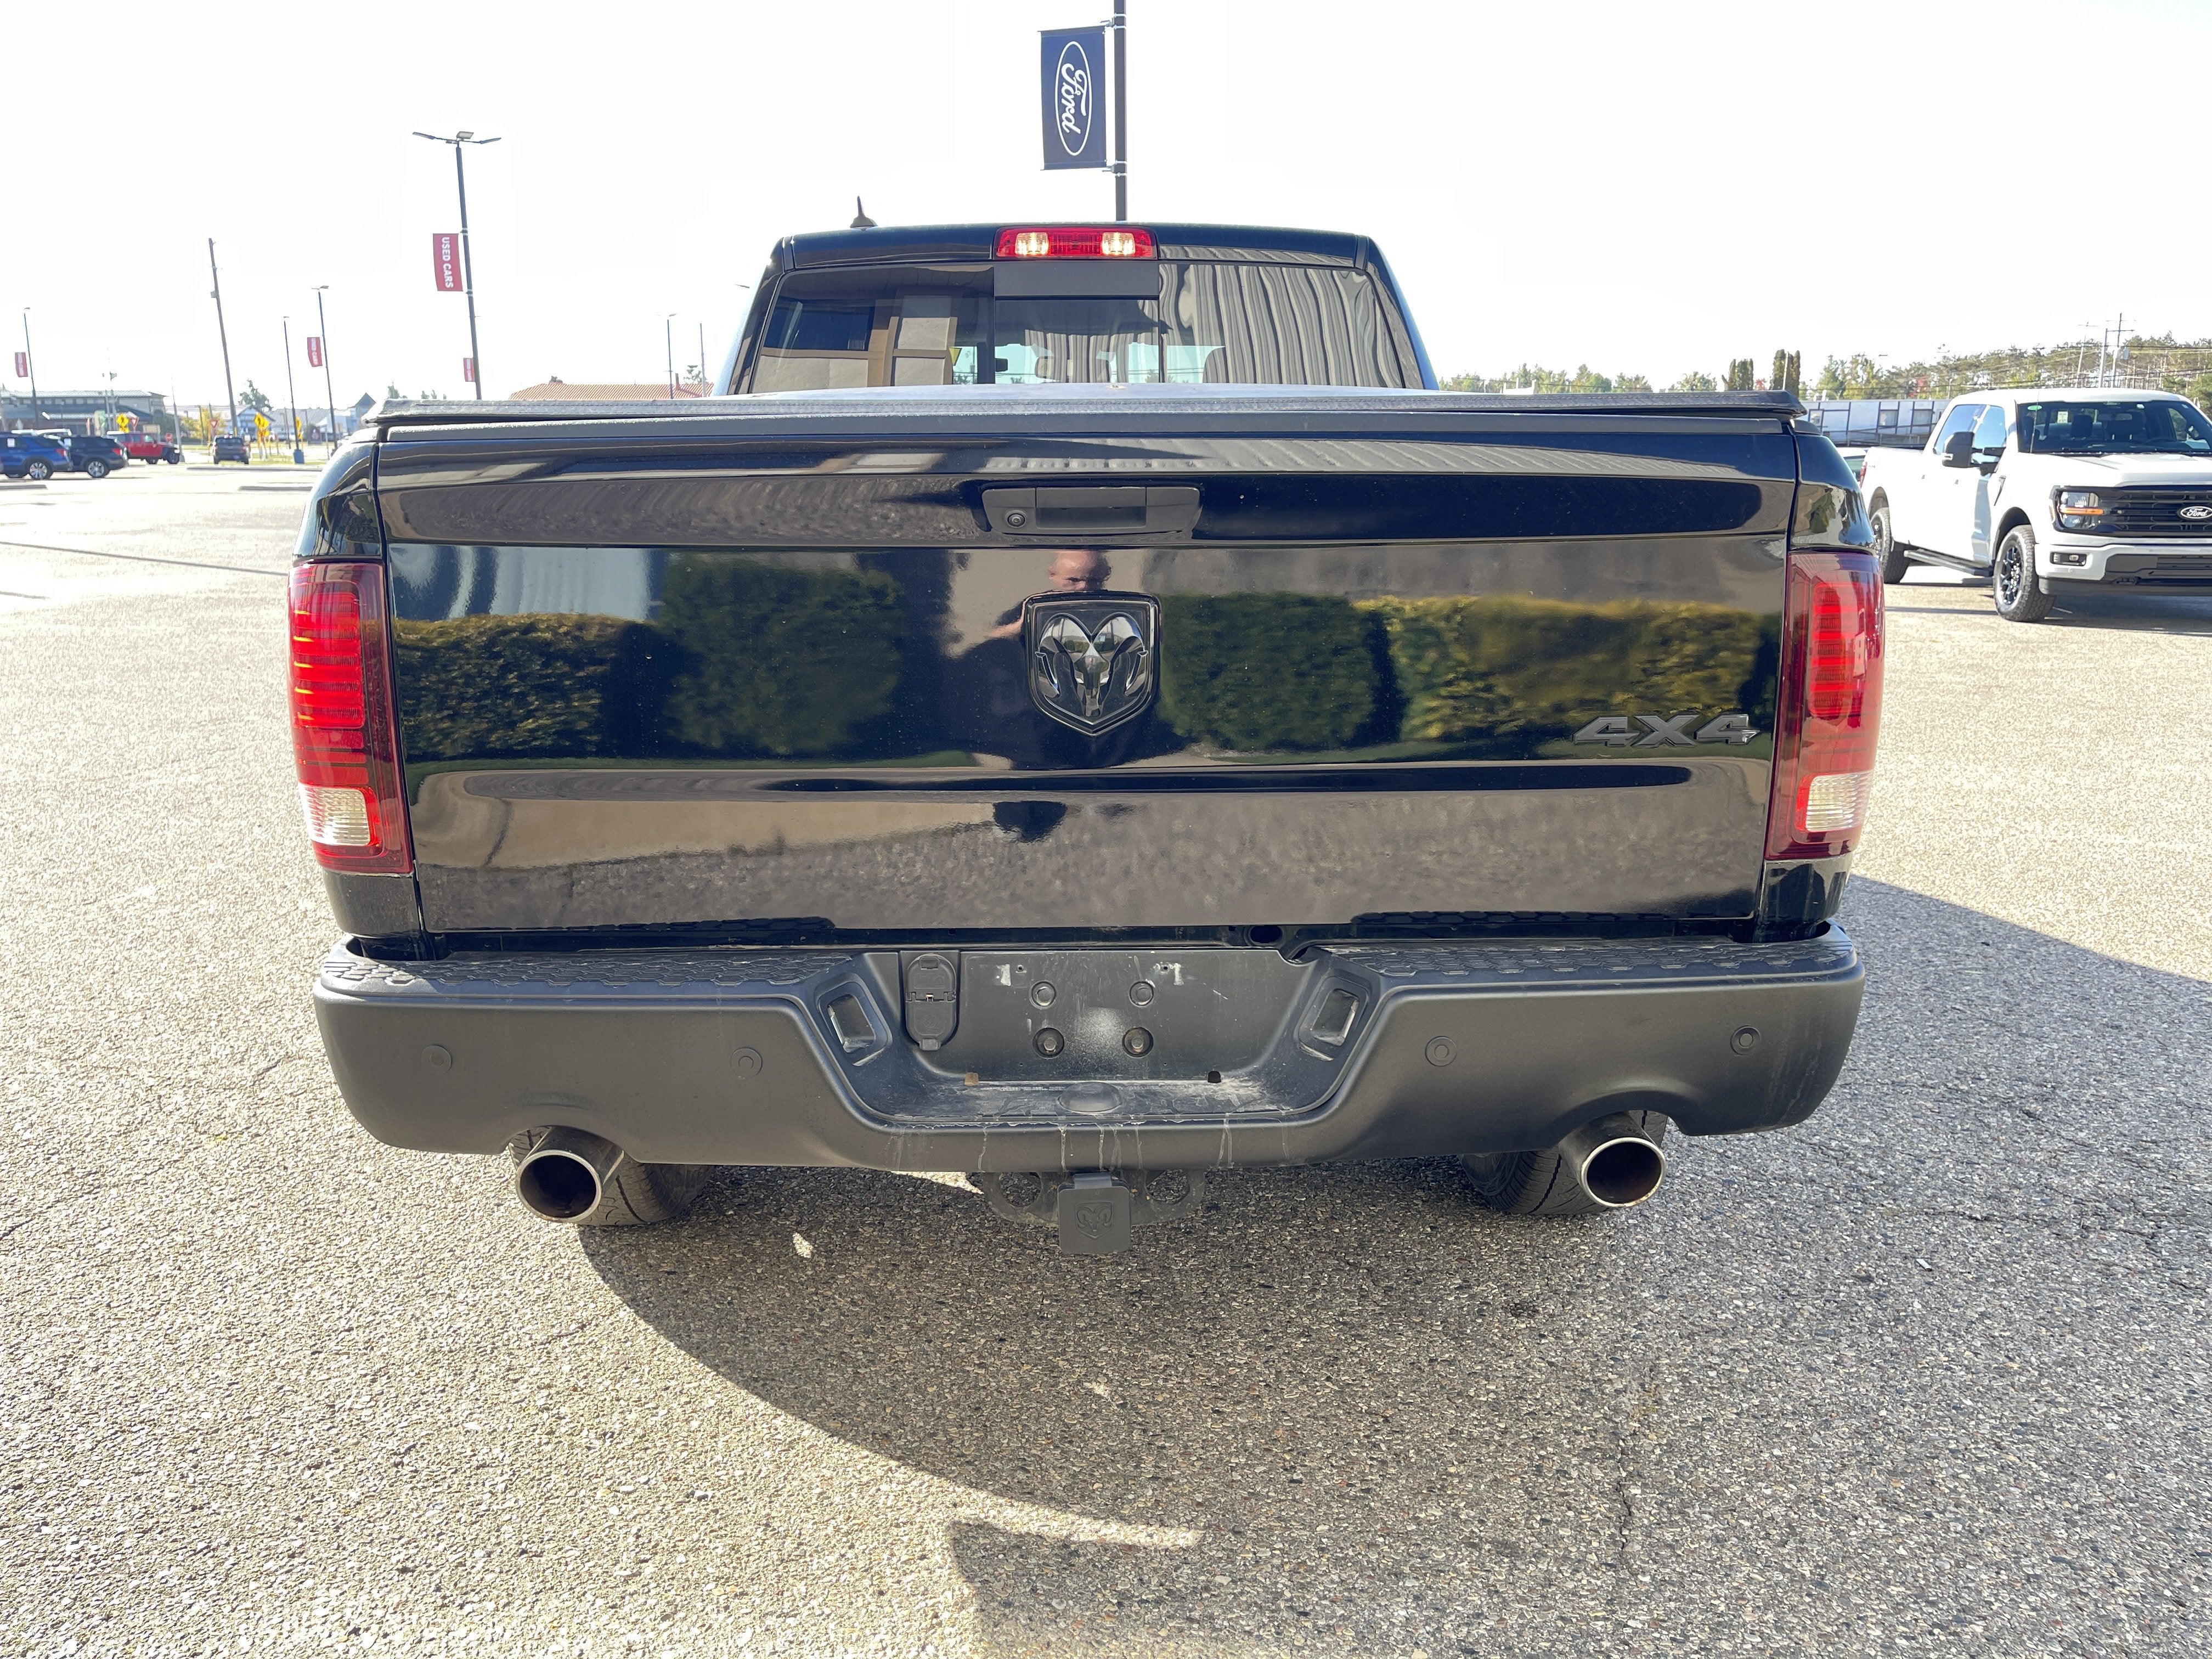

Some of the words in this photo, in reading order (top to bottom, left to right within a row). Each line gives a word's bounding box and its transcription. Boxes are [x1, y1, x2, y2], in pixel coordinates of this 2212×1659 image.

[1061, 63, 1088, 134] Ford
[442, 236, 450, 261] USED
[443, 263, 454, 288] CARS
[2187, 508, 2208, 517] Ford
